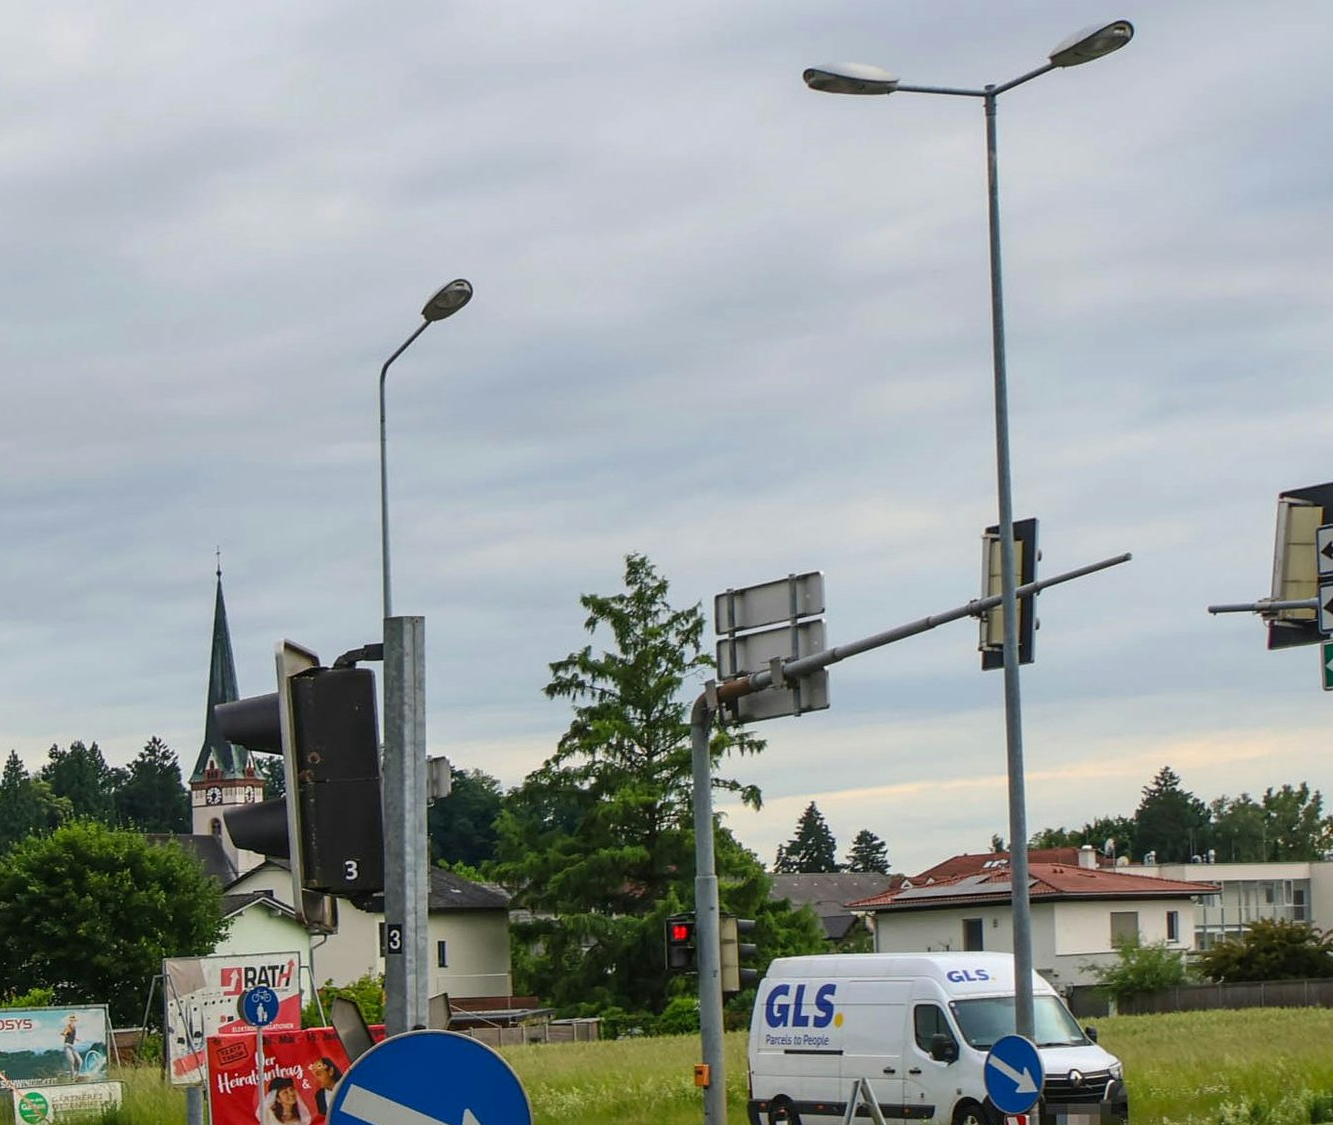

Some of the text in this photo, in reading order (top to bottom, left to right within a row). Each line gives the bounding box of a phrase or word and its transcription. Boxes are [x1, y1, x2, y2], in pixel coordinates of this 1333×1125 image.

[344, 860, 359, 880] 3
[389, 929, 402, 950] 3
[244, 958, 296, 988] RATH
[765, 1034, 830, 1048] Parcels to People
[301, 1079, 312, 1090] &
